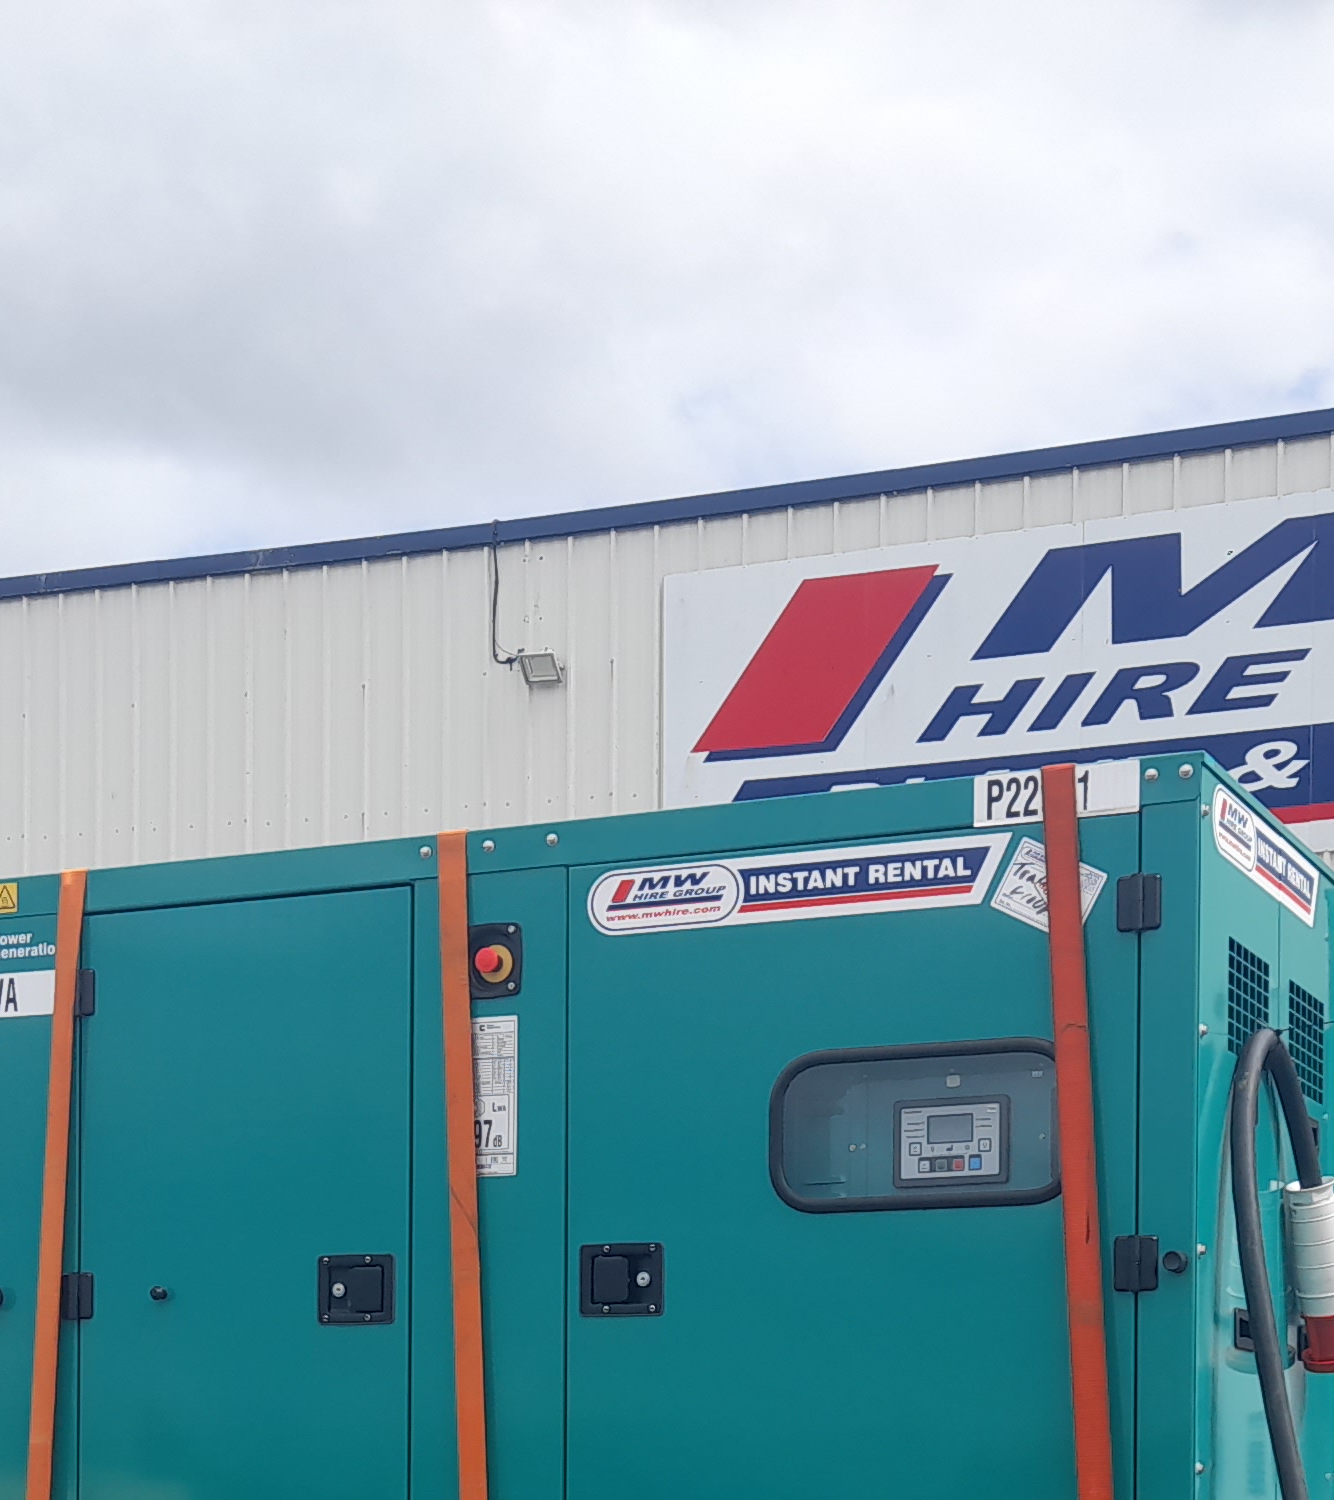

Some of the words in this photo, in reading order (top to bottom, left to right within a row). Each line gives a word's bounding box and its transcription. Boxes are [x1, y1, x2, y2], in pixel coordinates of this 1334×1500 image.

[916, 648, 1313, 743] HIRE
[1244, 740, 1310, 792] &
[1228, 803, 1249, 829] MW
[637, 871, 710, 891] MW
[749, 866, 860, 895] INSTANT
[869, 858, 972, 886] RENTAL
[1257, 837, 1287, 877] INSTANT
[1287, 863, 1311, 900] RENTAL
[633, 890, 669, 901] HIRE
[672, 885, 727, 898] GROUP
[606, 905, 722, 922] www.mwhire.com
[473, 1119, 493, 1148] 97
